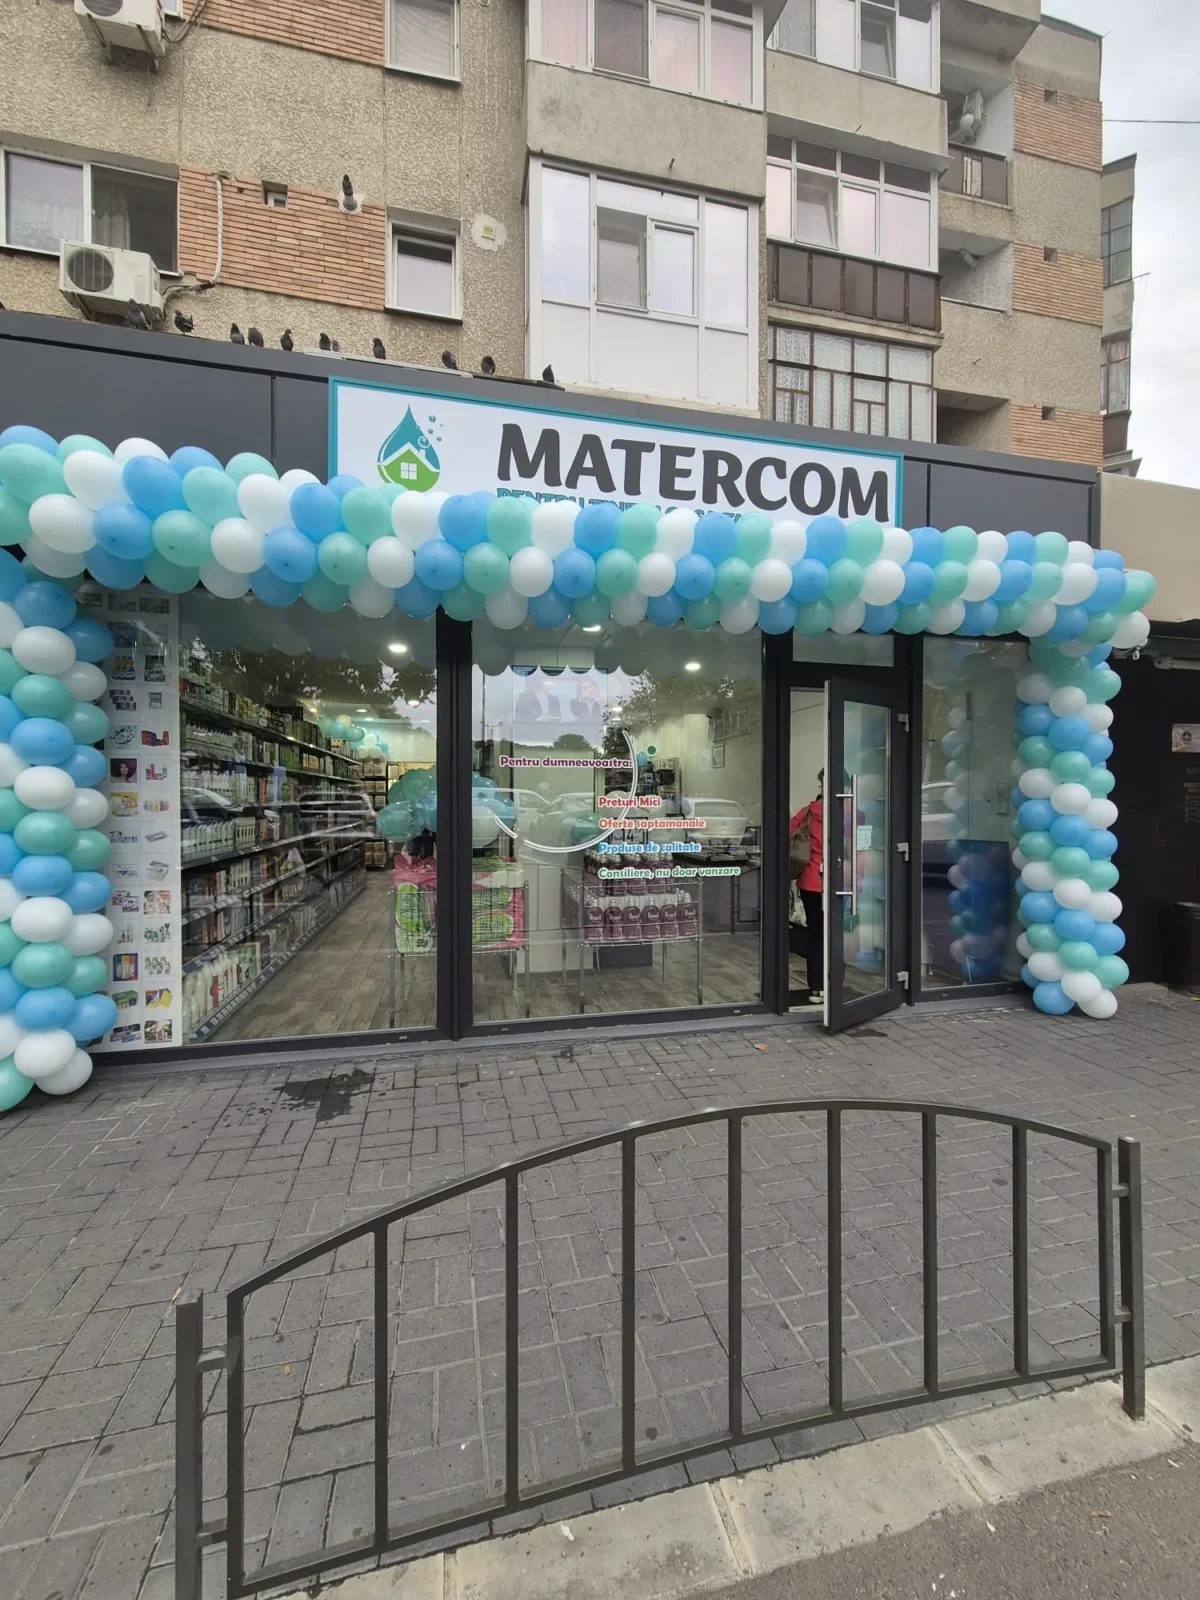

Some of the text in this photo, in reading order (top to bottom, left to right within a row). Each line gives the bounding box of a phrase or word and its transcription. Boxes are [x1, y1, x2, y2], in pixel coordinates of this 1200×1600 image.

[497, 422, 889, 523] MATERCOM
[500, 756, 632, 768] Pentru dumneavoastra:
[598, 797, 660, 807] Preturi Mici
[598, 818, 705, 830] Oferte saptamanale
[598, 842, 700, 853] Produse de calitate
[598, 866, 741, 879] Consiliere, nu doar vanzare
